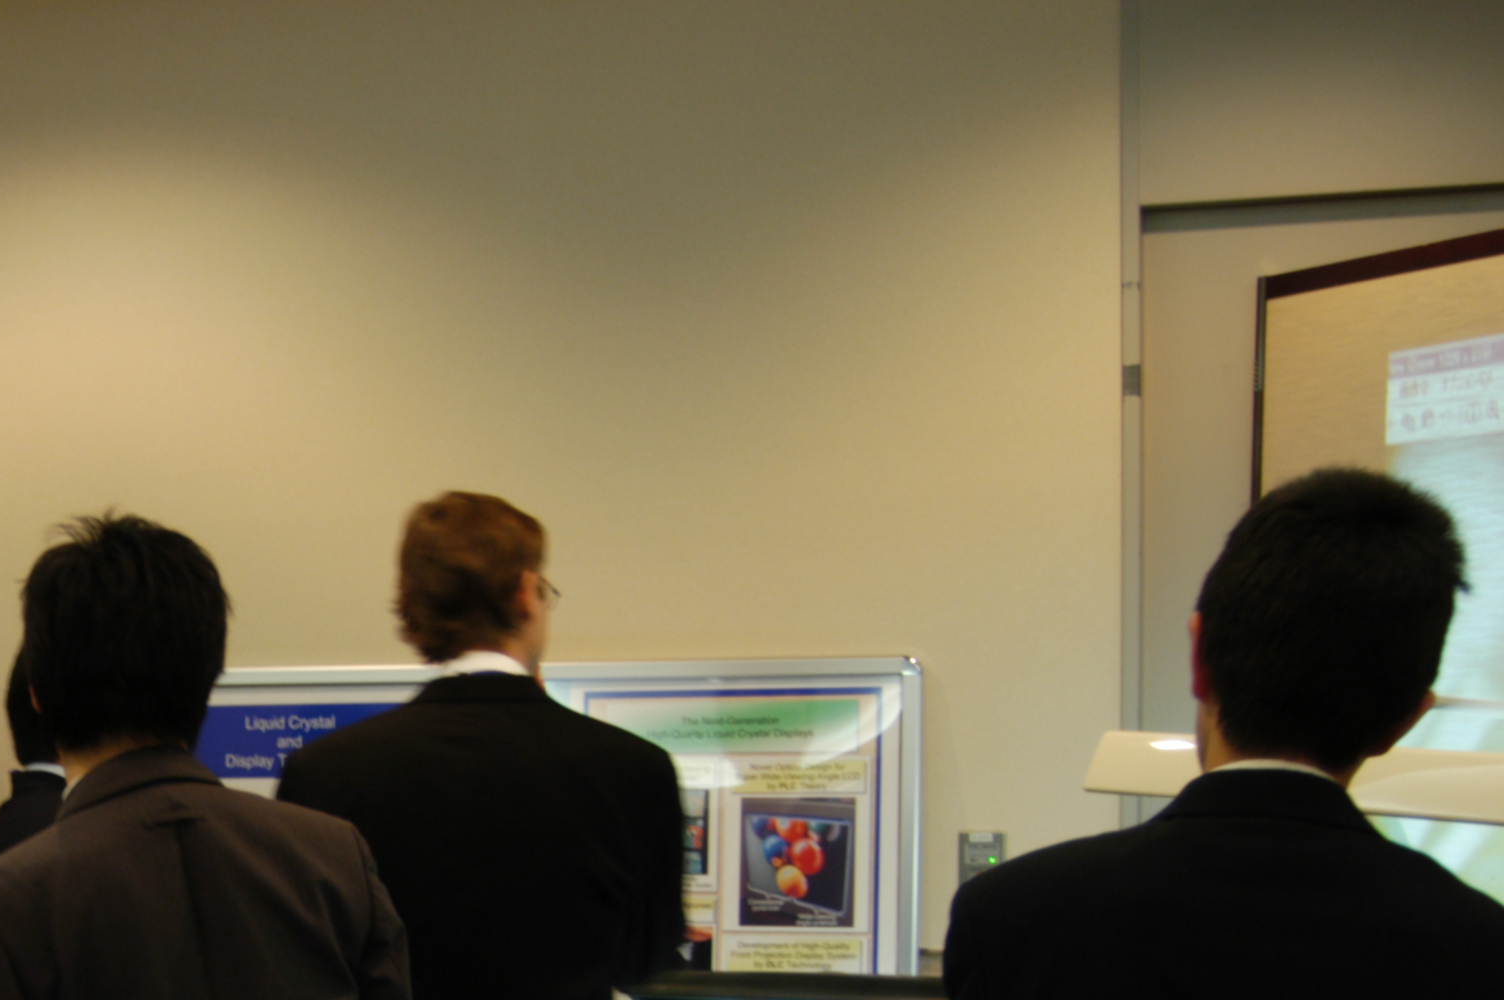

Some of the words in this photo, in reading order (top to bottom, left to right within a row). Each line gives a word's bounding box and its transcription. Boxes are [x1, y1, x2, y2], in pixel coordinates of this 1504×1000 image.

[244, 715, 286, 733] Liquid
[288, 714, 336, 733] Crystal
[681, 715, 700, 726] The
[701, 715, 779, 727] Next-Generation
[708, 727, 736, 741] Liquid
[737, 727, 771, 741] Crystal
[774, 727, 814, 741] Displays
[276, 734, 303, 749] and
[224, 753, 275, 771] Display
[749, 763, 772, 772] Novel
[842, 771, 861, 782] LCD
[766, 782, 777, 792] by
[737, 941, 790, 952] Development
[792, 942, 799, 950] of
[796, 951, 823, 961] Display
[754, 961, 763, 970] by
